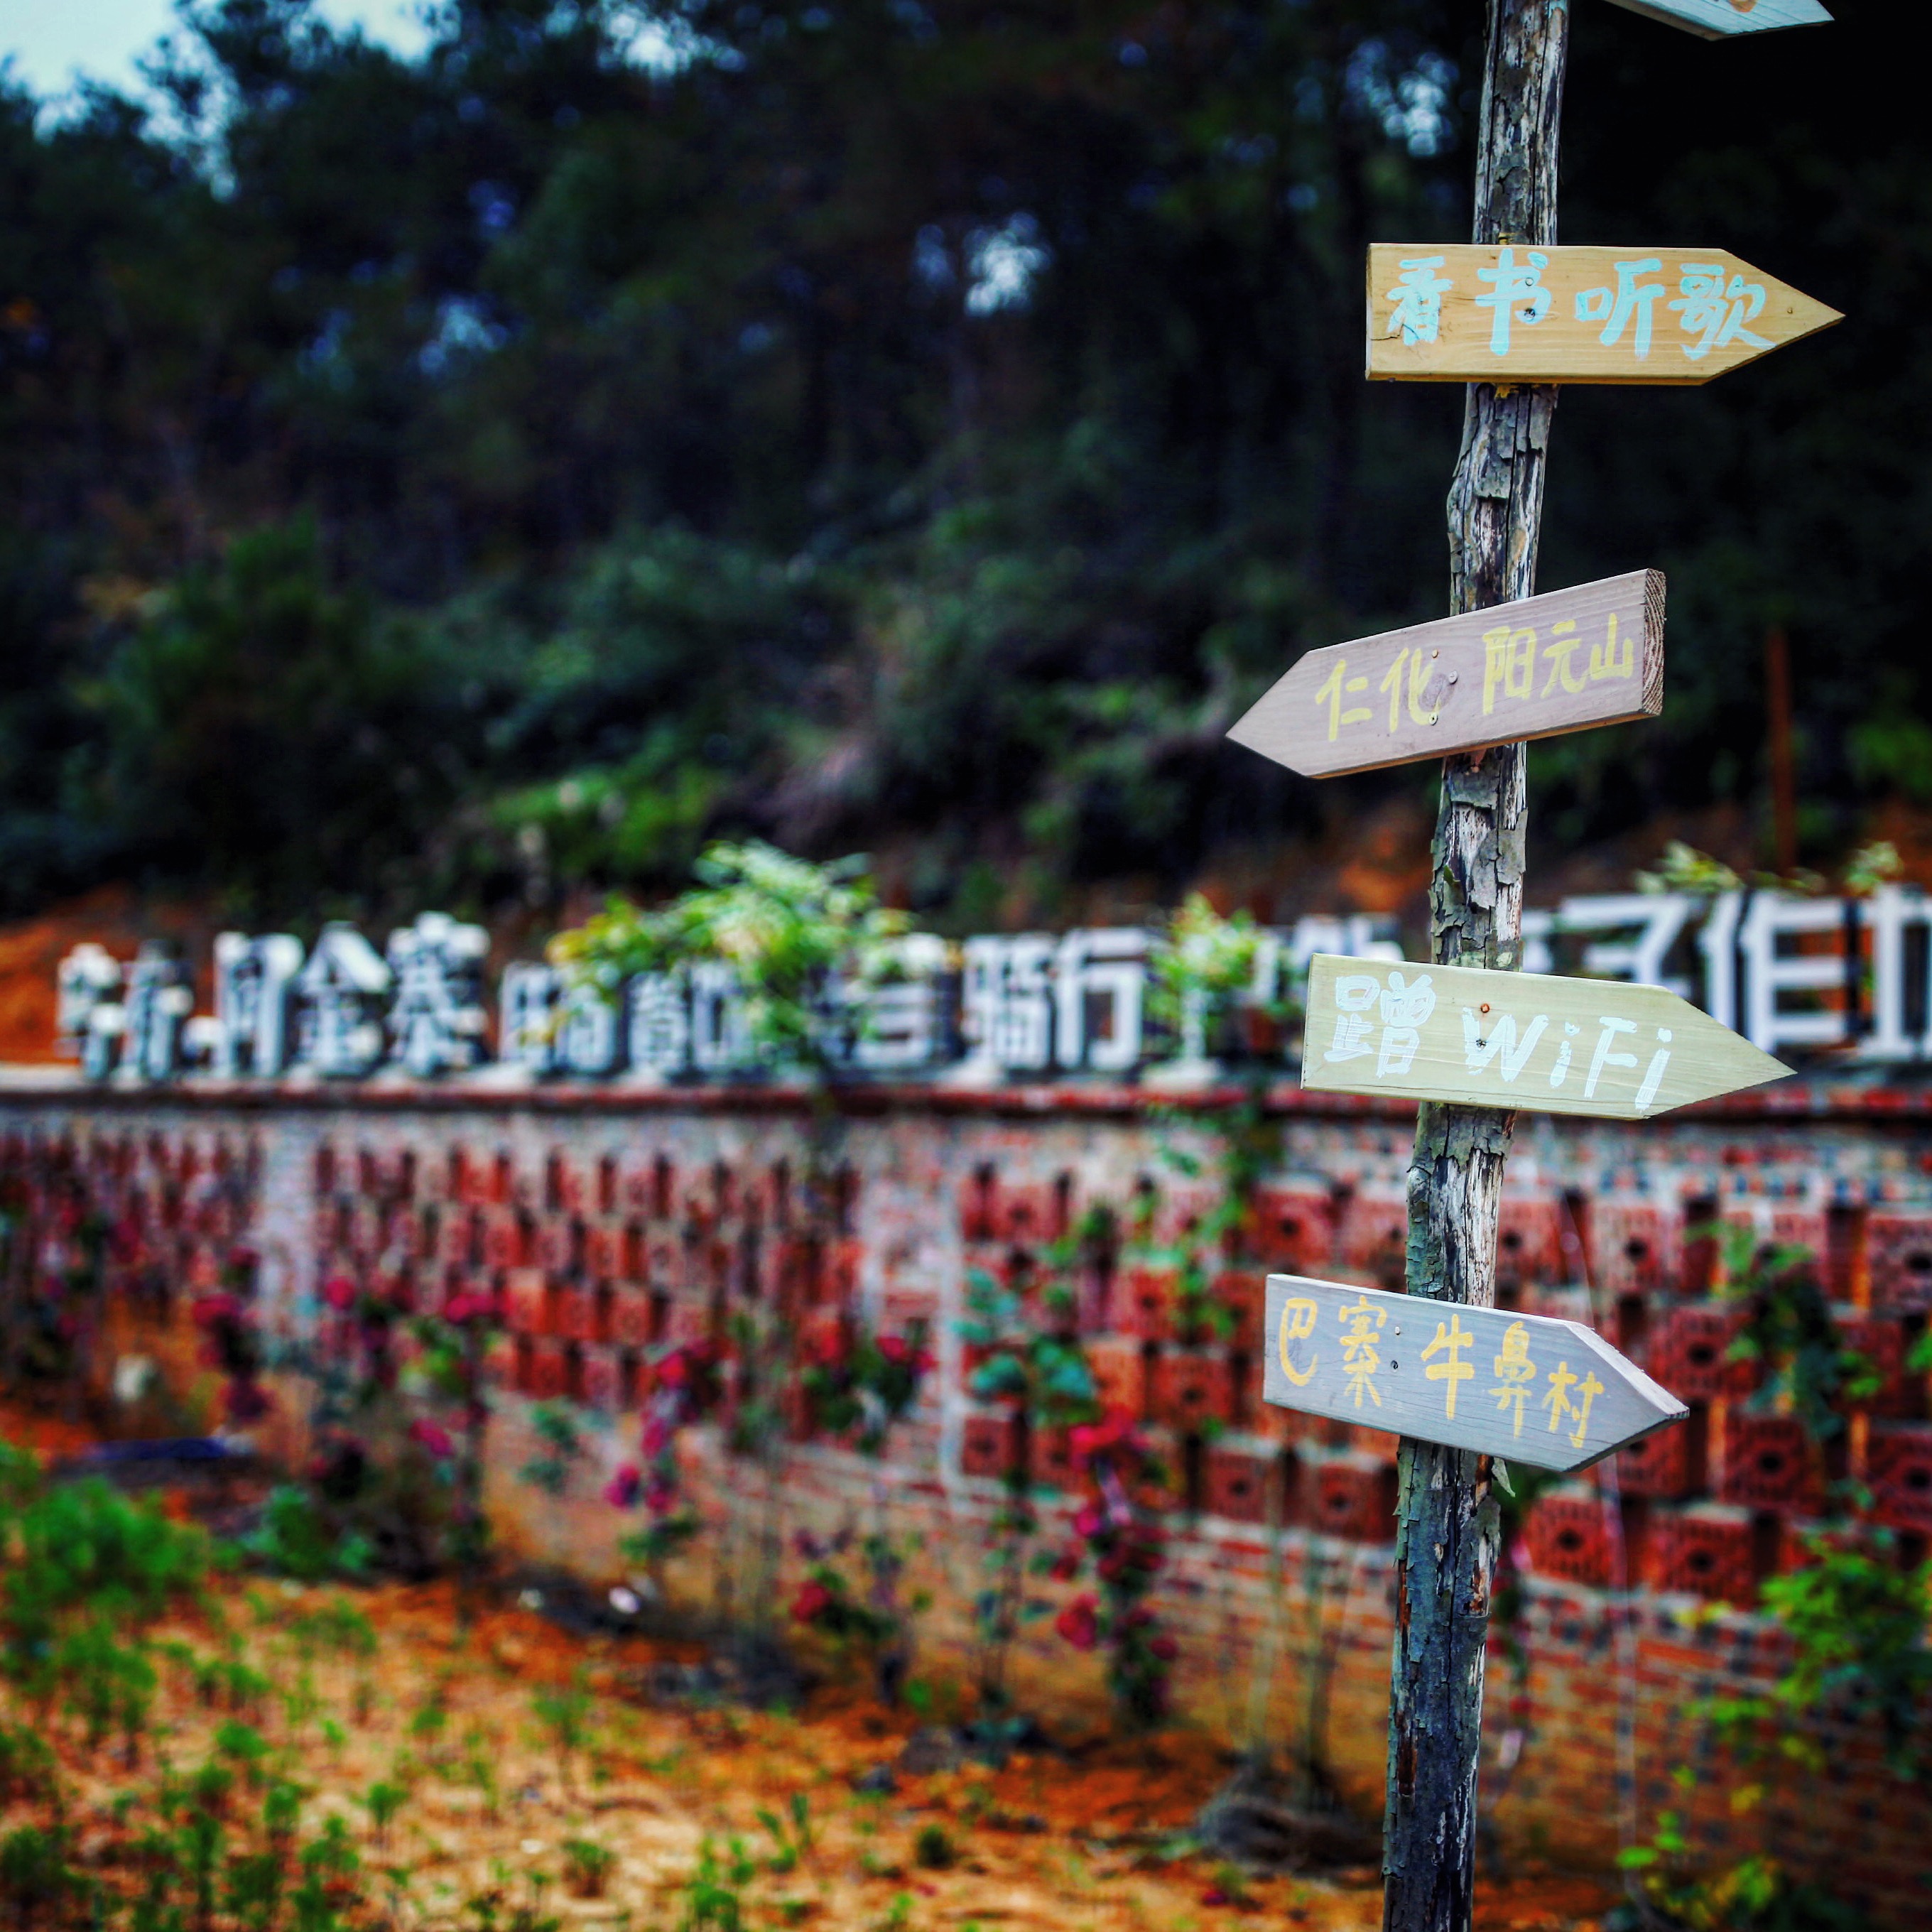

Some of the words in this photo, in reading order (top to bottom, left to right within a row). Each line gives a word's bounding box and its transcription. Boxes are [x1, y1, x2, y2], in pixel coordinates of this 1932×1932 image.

[1386, 247, 1776, 361] 看书听歌
[1323, 970, 1437, 1079] 蹭
[1462, 1006, 1673, 1110] WiFi
